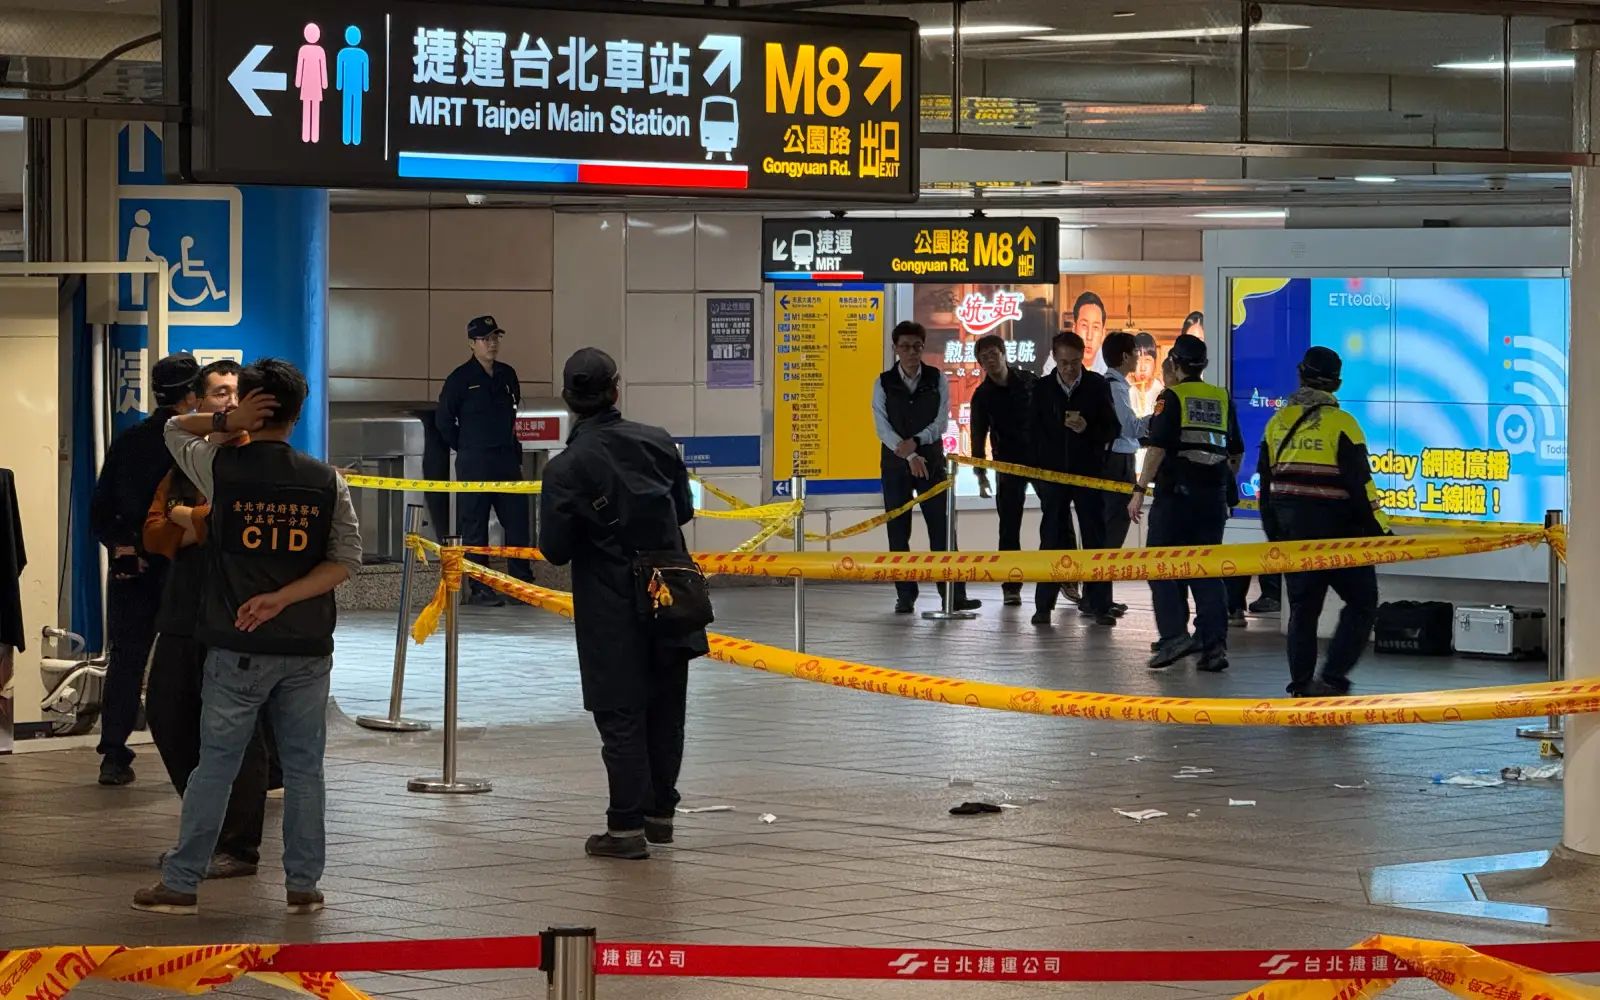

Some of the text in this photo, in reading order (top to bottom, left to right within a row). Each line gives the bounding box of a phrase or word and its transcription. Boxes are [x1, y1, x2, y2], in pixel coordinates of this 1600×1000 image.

[412, 27, 690, 97] 捷運台北車站
[765, 42, 850, 117] M8
[410, 96, 690, 137] MRT Taipei Main Station
[784, 124, 851, 156] 公園路
[859, 119, 900, 178] 出口
[763, 157, 850, 178] Gongyuan Rd.
[880, 162, 900, 177] EXIT
[816, 229, 853, 255] 捷運
[914, 229, 970, 255] 公園路
[974, 232, 1014, 267] M8
[815, 258, 842, 271] MRT
[892, 258, 970, 273] Gongyuan Rd.
[960, 291, 1022, 322] 統一麵
[1328, 292, 1392, 310] ETtoday
[1421, 449, 1509, 480] 網路廣播
[244, 513, 309, 528] 中正第一分局
[242, 525, 308, 552] CID
[602, 949, 686, 968] 捷運公司
[932, 955, 1061, 975] 台北捷運公司
